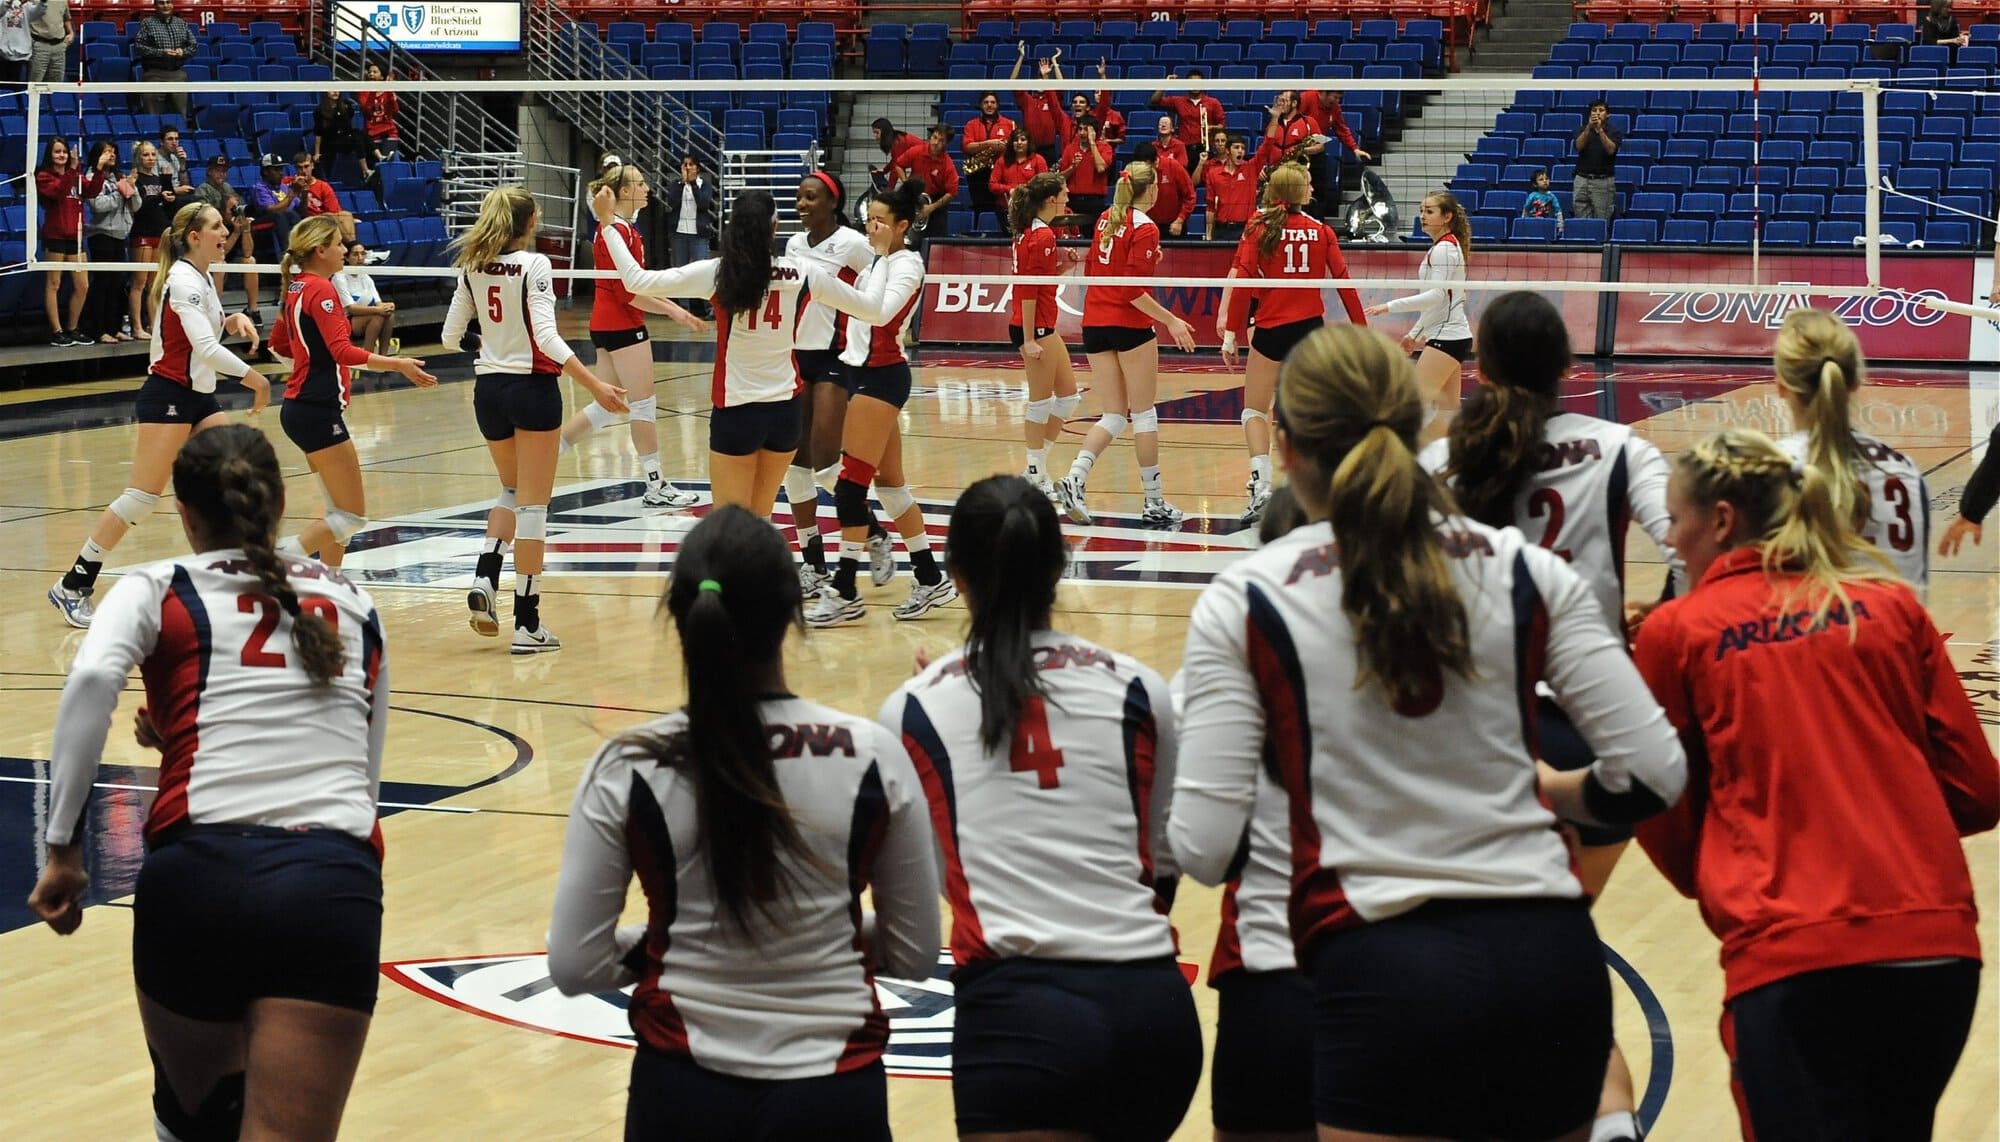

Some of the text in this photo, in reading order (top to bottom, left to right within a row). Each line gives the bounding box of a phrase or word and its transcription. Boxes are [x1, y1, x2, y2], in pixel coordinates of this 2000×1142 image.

[200, 11, 215, 26] 18
[430, 5, 478, 14] BlueCross
[1151, 11, 1170, 22] 20
[1809, 12, 1824, 24] 21
[430, 16, 482, 25] BlueShield
[430, 27, 479, 36] of Arizona
[1280, 228, 1319, 241] UTAH
[1098, 238, 1114, 264] 9
[1283, 243, 1310, 273] 11
[487, 285, 503, 323] 5
[748, 290, 782, 330] 14
[1828, 289, 1948, 326] ZOO
[1529, 488, 1572, 563] 2
[1009, 694, 1065, 790] 4
